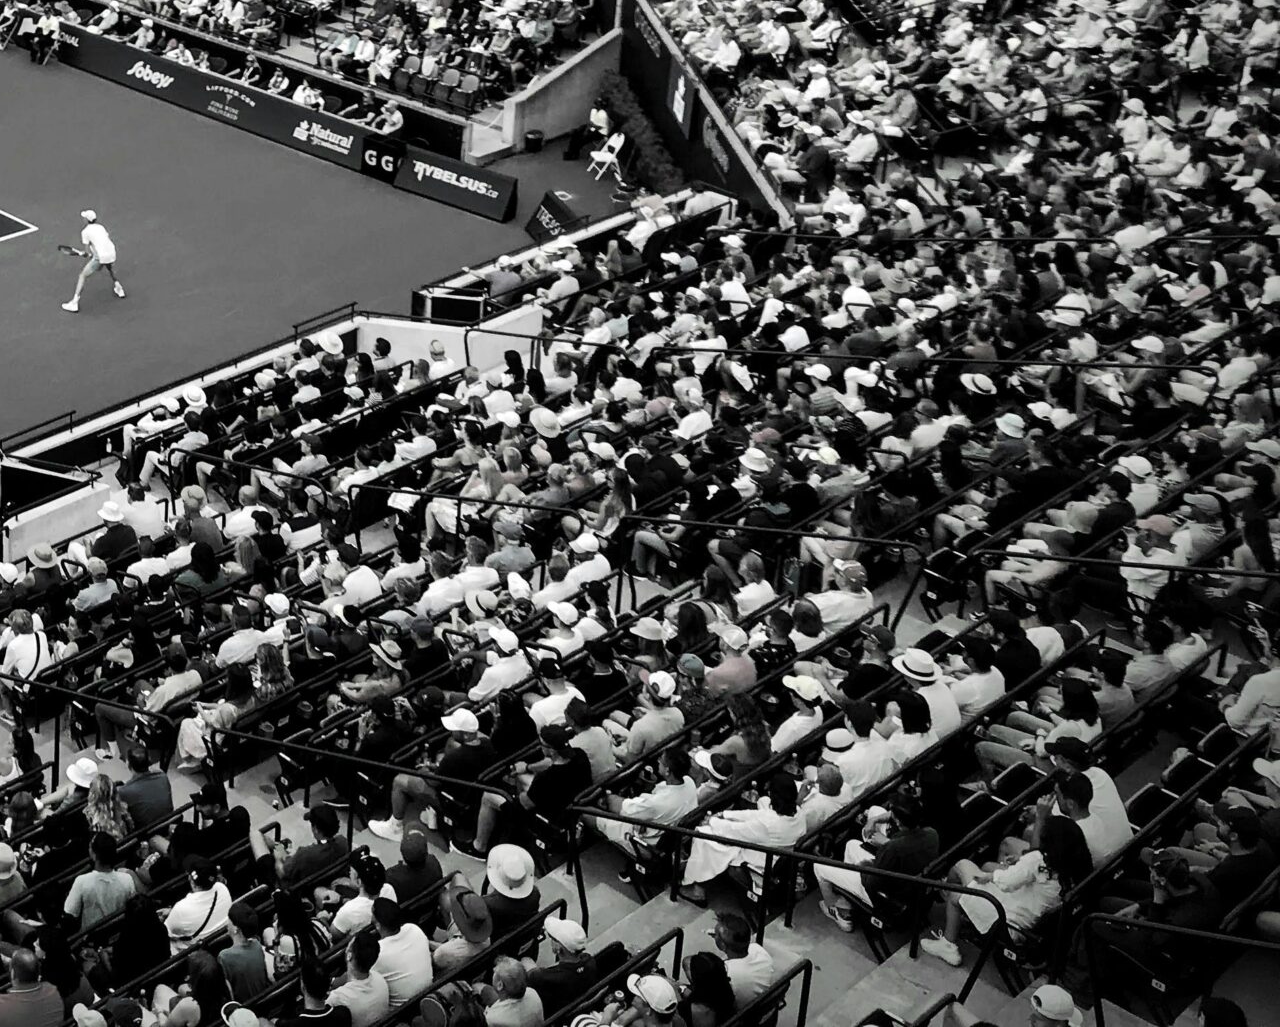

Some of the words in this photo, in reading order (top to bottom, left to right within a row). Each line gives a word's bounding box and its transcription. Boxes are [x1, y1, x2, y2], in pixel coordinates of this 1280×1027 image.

[58, 30, 80, 48] ONAL
[126, 61, 175, 89] Sobeys
[310, 122, 354, 149] Natural
[364, 149, 378, 167] G
[380, 155, 394, 172] G
